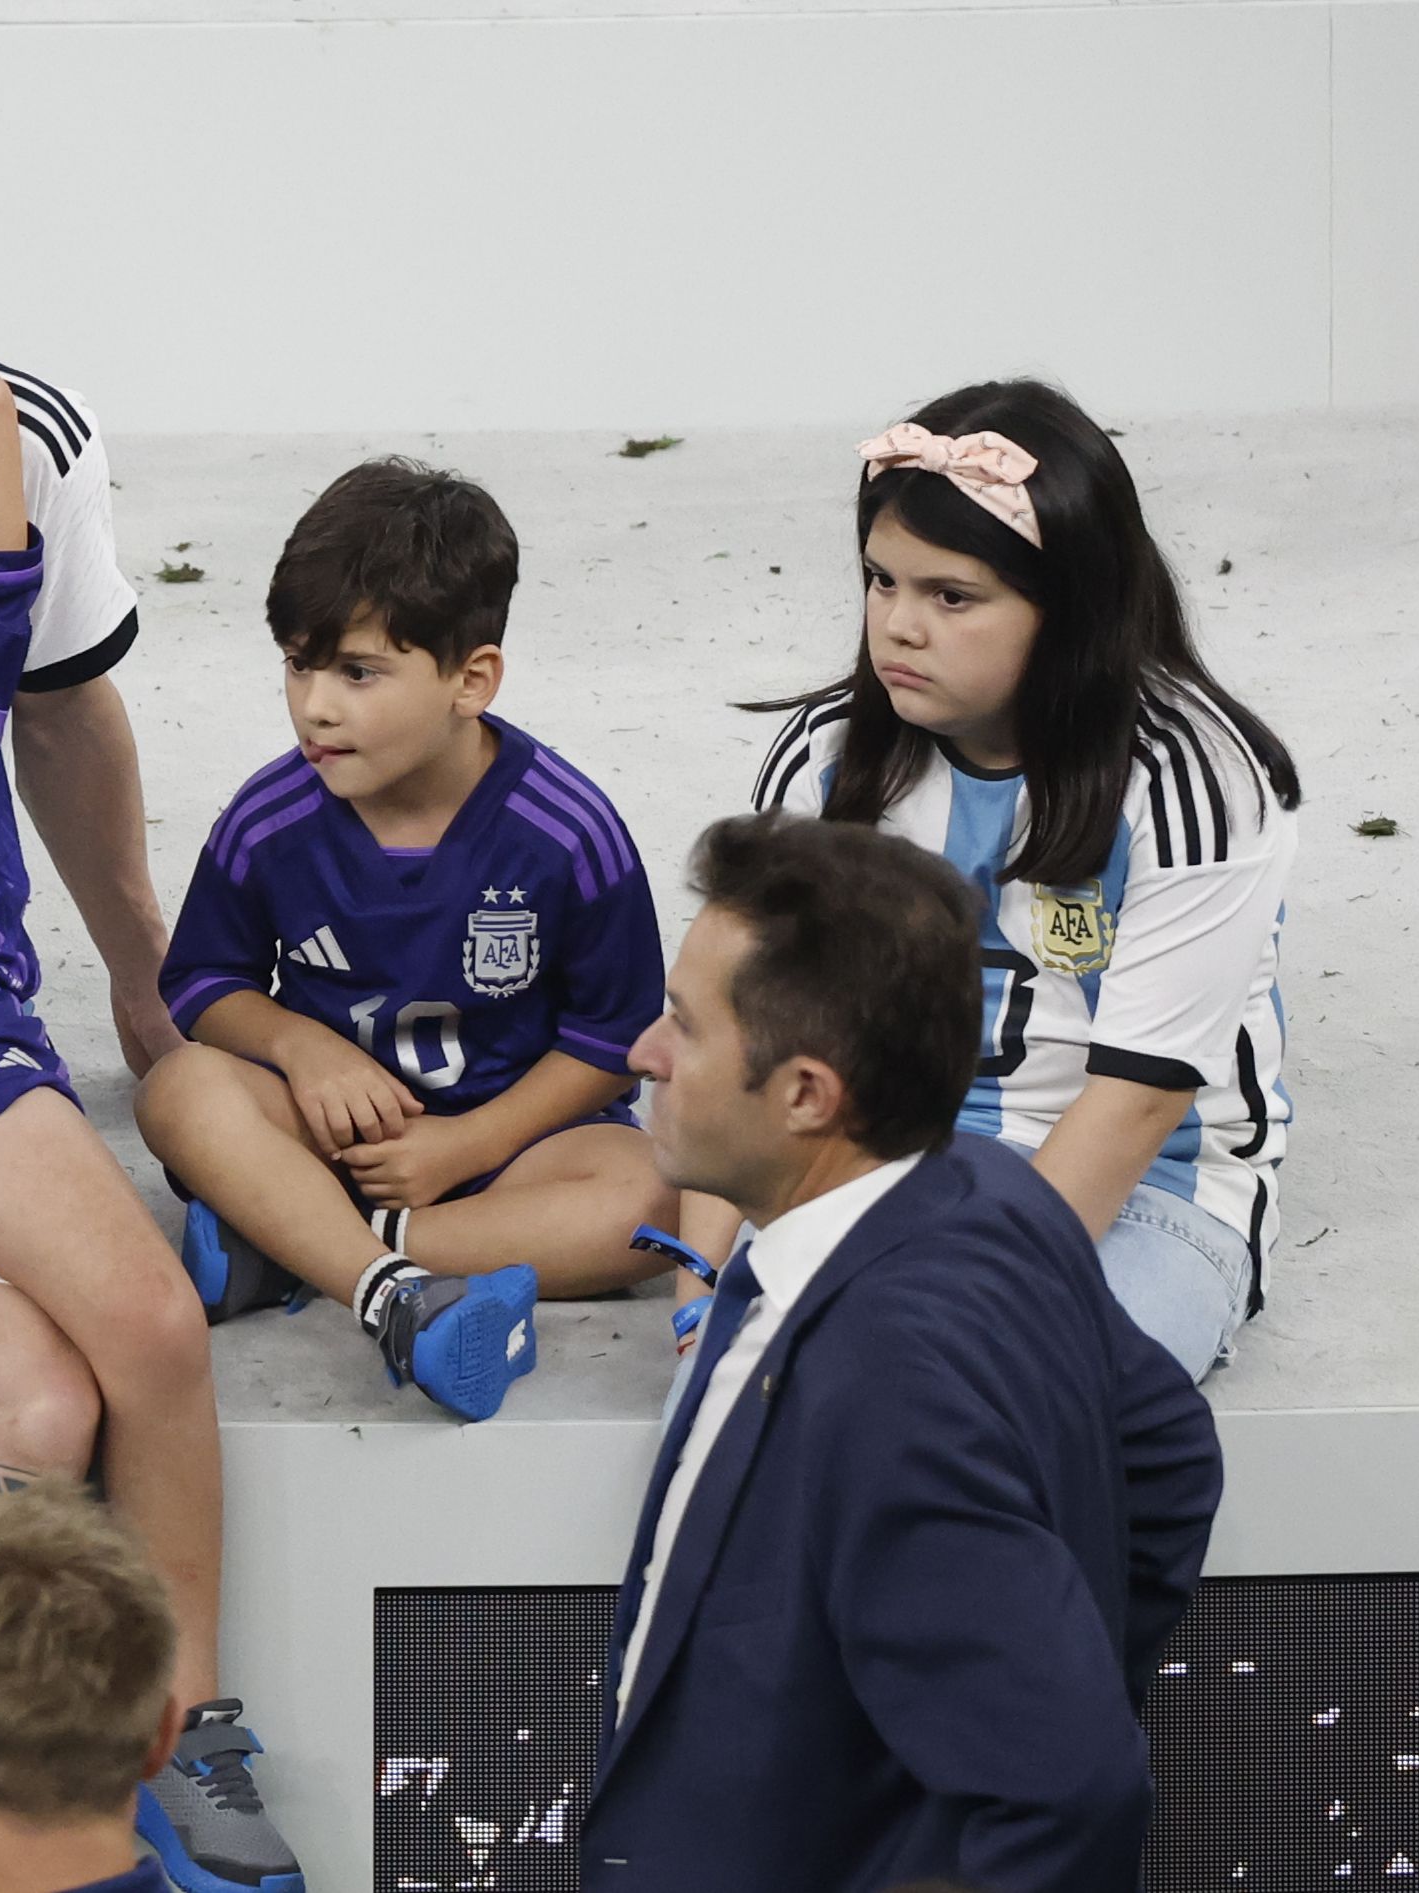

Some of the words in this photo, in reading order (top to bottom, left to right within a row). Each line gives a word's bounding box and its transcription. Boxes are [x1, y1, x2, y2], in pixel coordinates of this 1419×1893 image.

[1050, 898, 1093, 946] AFA
[482, 934, 522, 970] AFA
[349, 995, 467, 1090] 10
